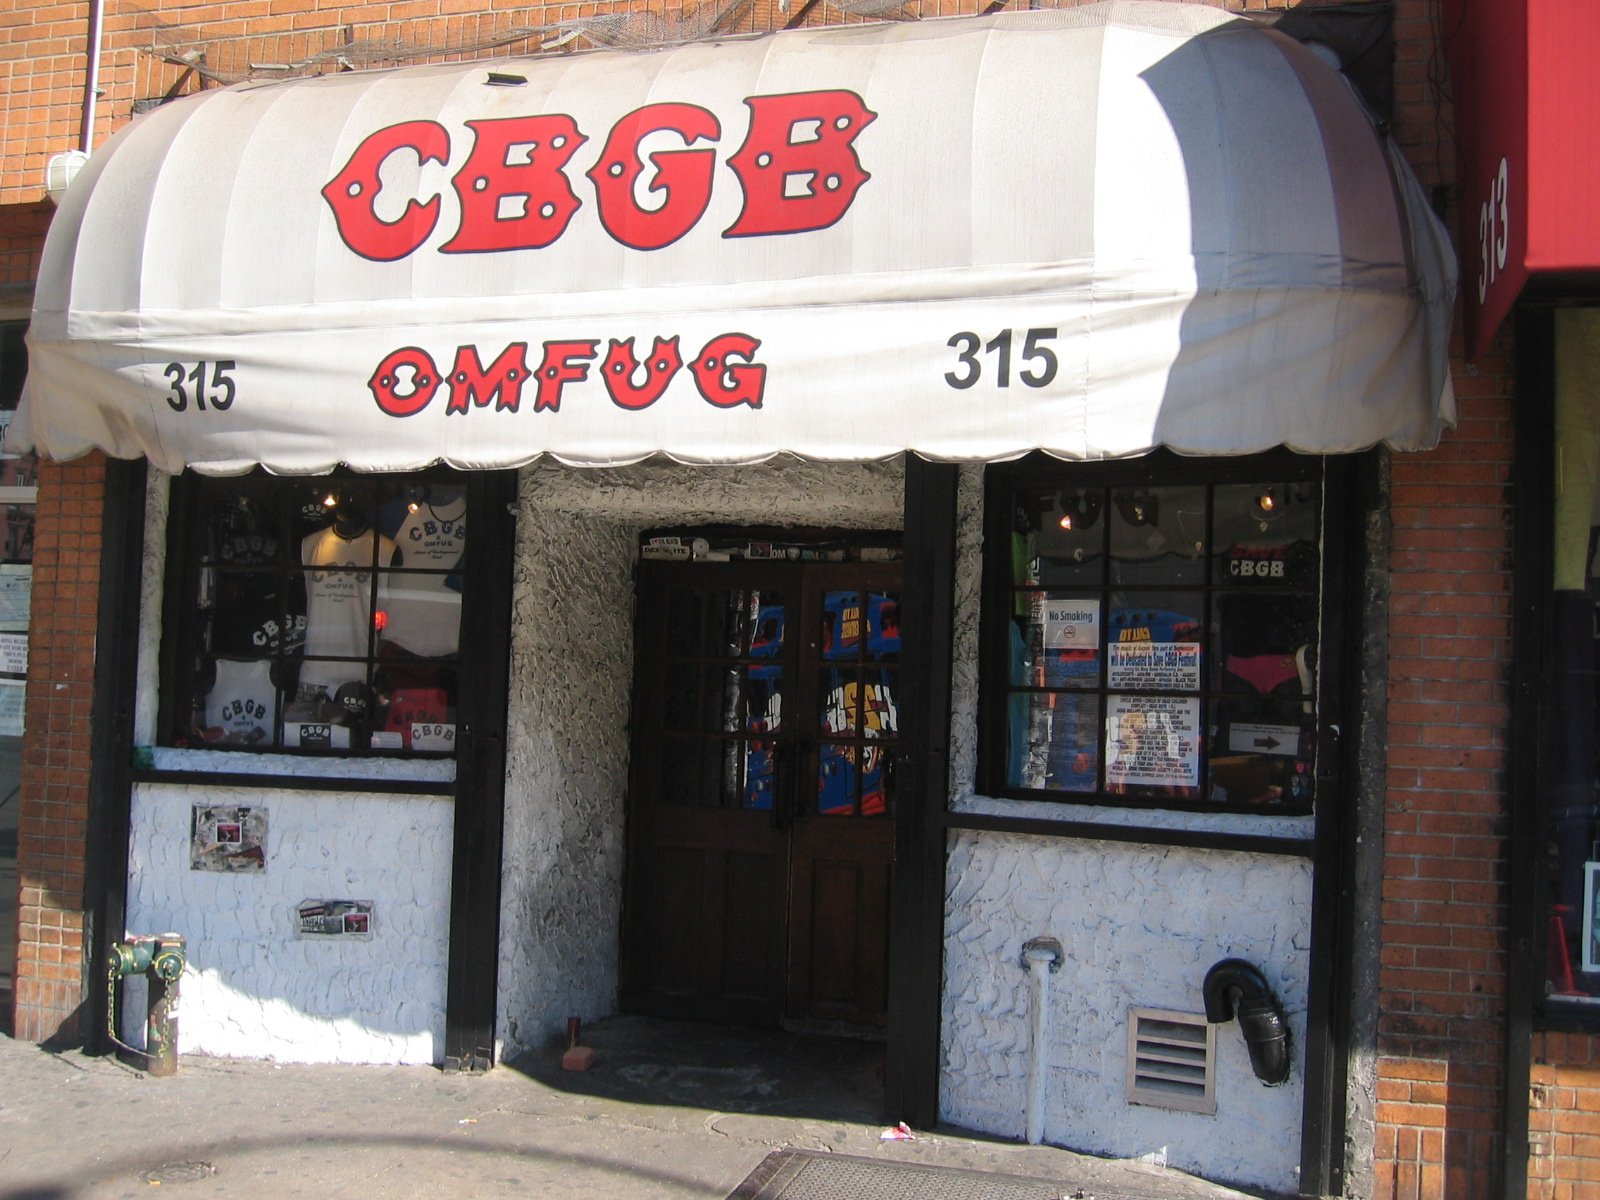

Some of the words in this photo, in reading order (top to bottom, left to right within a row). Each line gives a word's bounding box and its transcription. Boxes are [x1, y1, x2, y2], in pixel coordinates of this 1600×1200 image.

[321, 91, 876, 262] CBGB
[1479, 157, 1509, 305] 313
[368, 333, 766, 417] OMFUG
[945, 328, 1058, 390] 315
[165, 360, 236, 413] 315
[1231, 560, 1285, 577] CBGB
[1049, 610, 1059, 621] No
[1060, 610, 1093, 623] Smoking
[223, 699, 266, 721] CBGB
[301, 725, 330, 737] CBGB
[411, 724, 454, 742] CBGB
